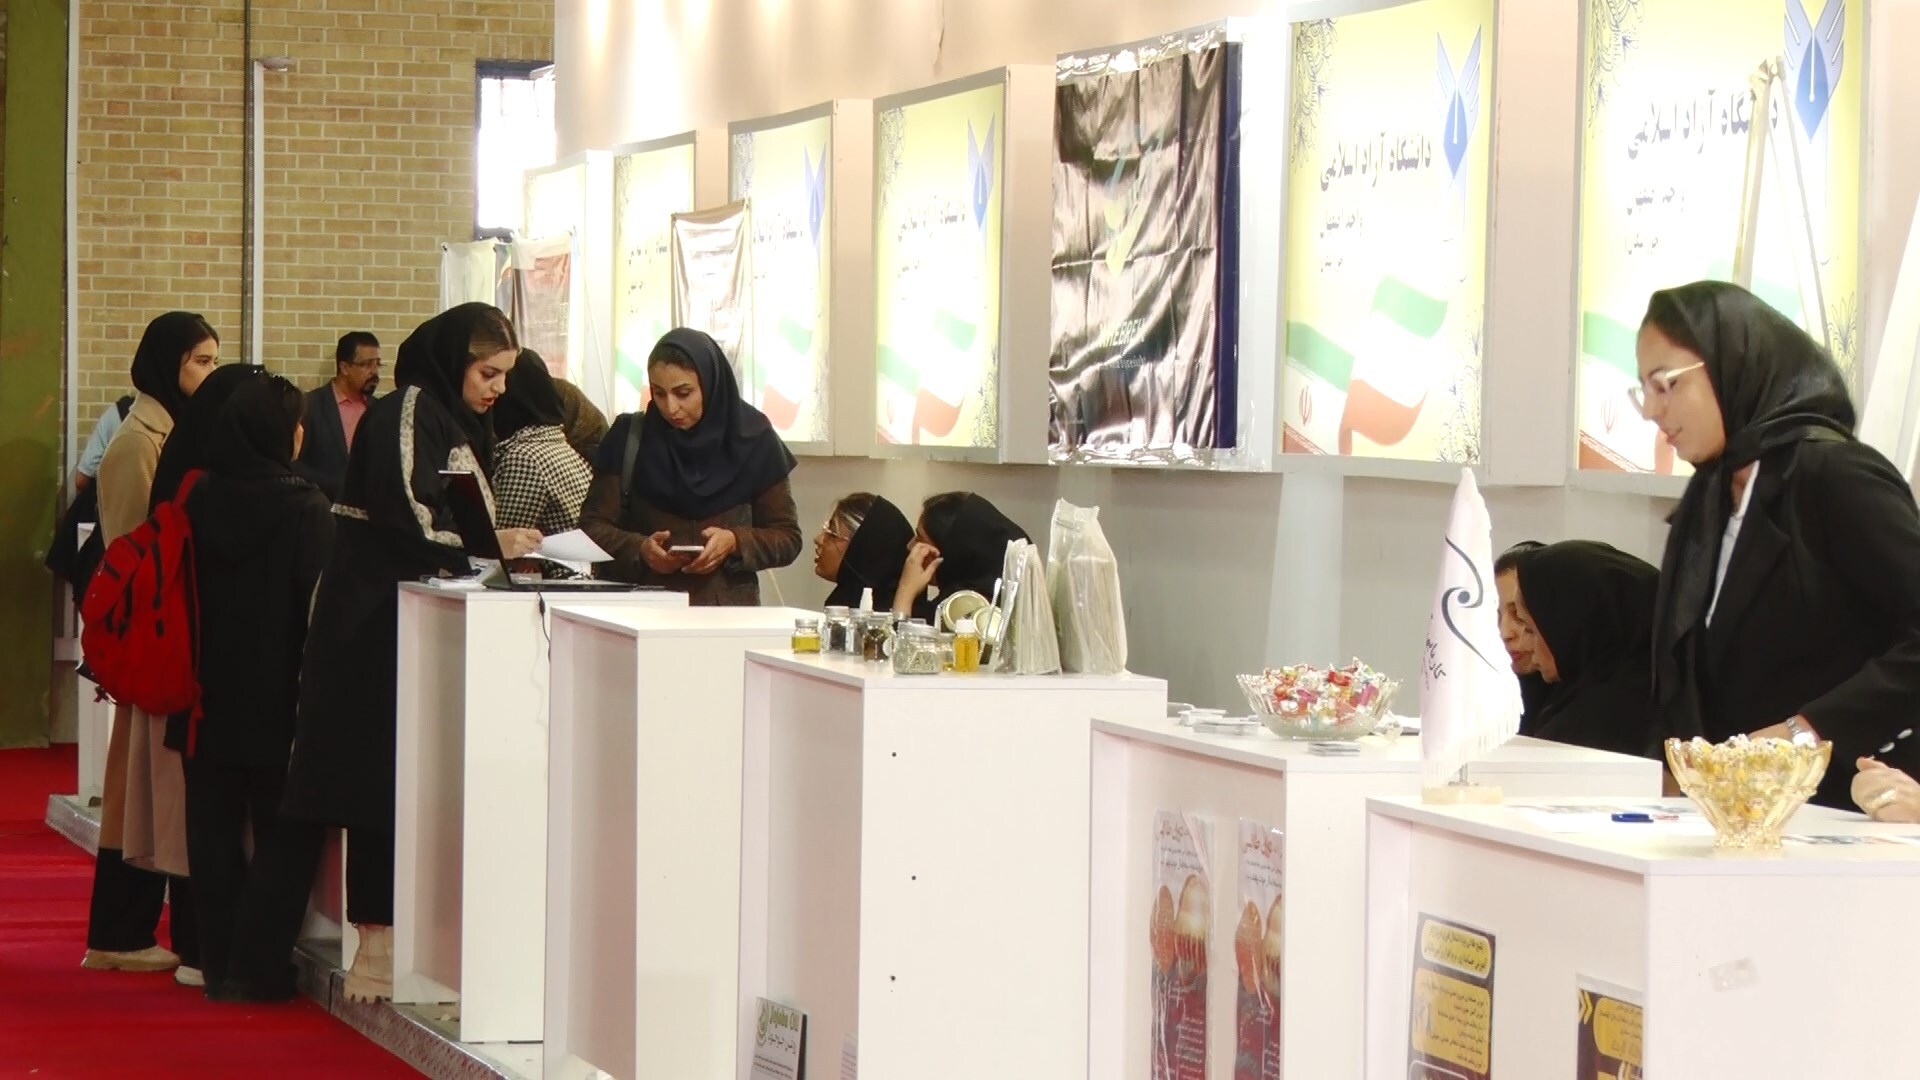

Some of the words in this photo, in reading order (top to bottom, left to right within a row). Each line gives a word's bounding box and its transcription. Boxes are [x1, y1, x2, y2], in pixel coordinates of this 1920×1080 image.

[1627, 100, 1678, 160] اسلامی
[1682, 88, 1715, 154] آزاد
[1720, 92, 1778, 136] دگاه
[1319, 139, 1359, 192] اسلامی
[1361, 131, 1386, 188] آزاد
[1389, 134, 1432, 172] دانشگاه
